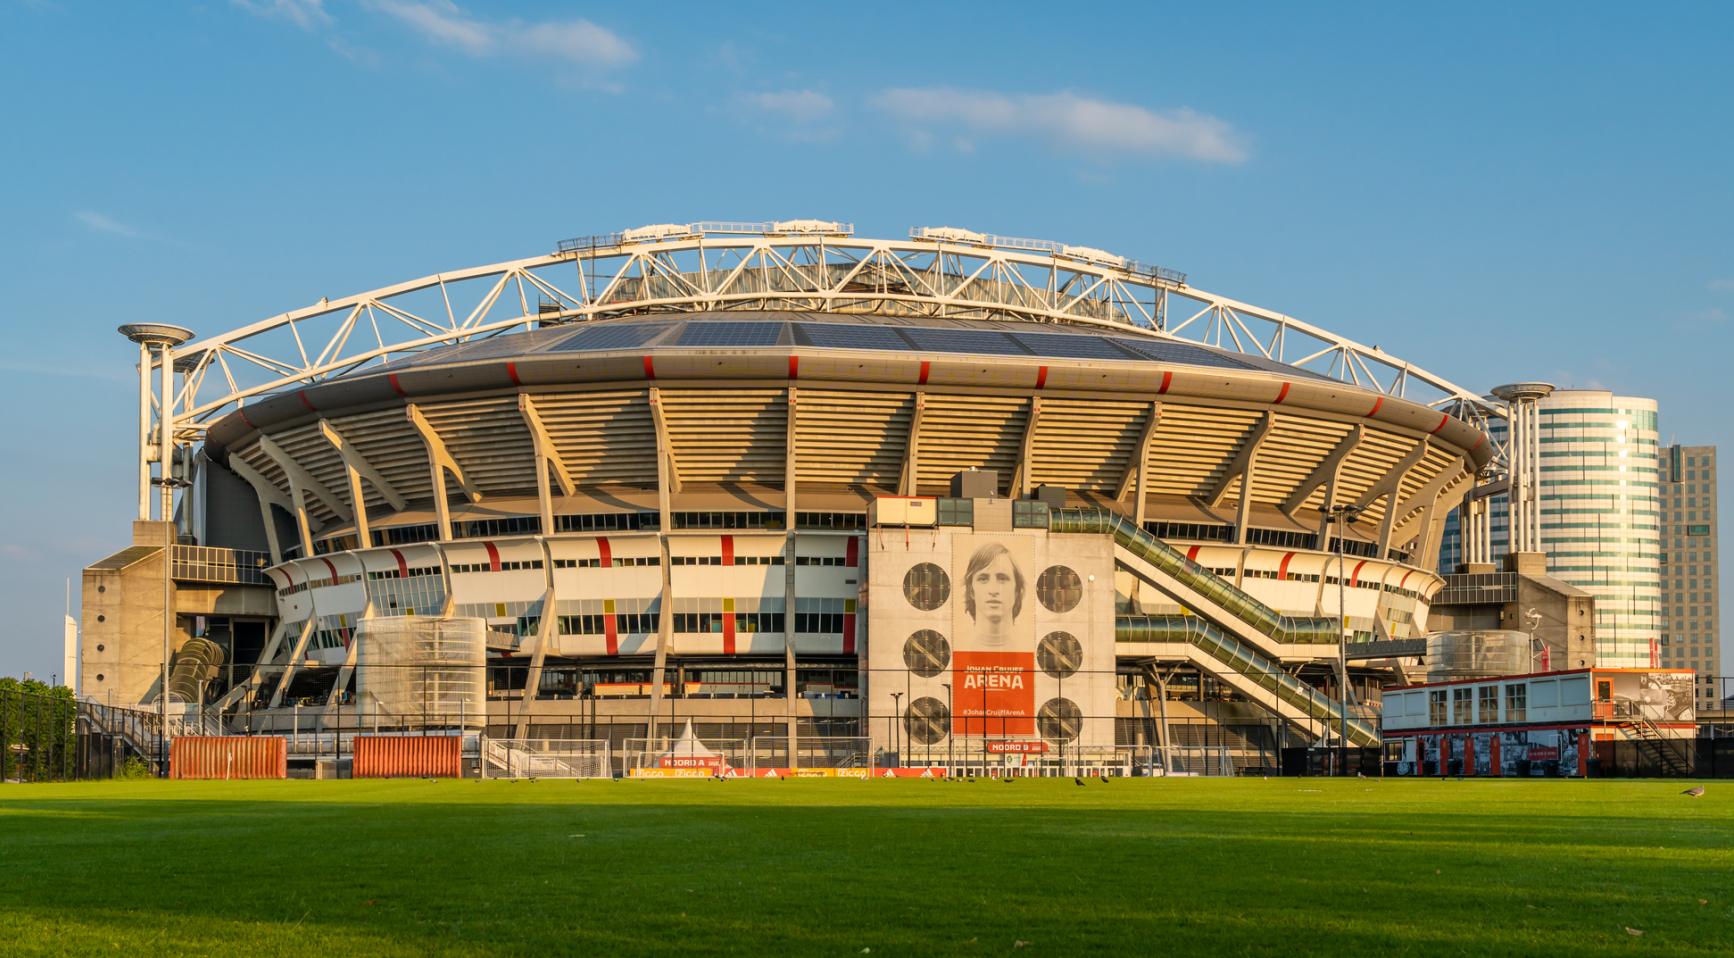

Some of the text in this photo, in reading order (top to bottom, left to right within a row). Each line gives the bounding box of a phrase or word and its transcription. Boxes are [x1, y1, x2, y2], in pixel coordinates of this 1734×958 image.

[964, 674, 1024, 689] ARENA
[664, 759, 697, 767] NOORD
[698, 759, 705, 767] A
